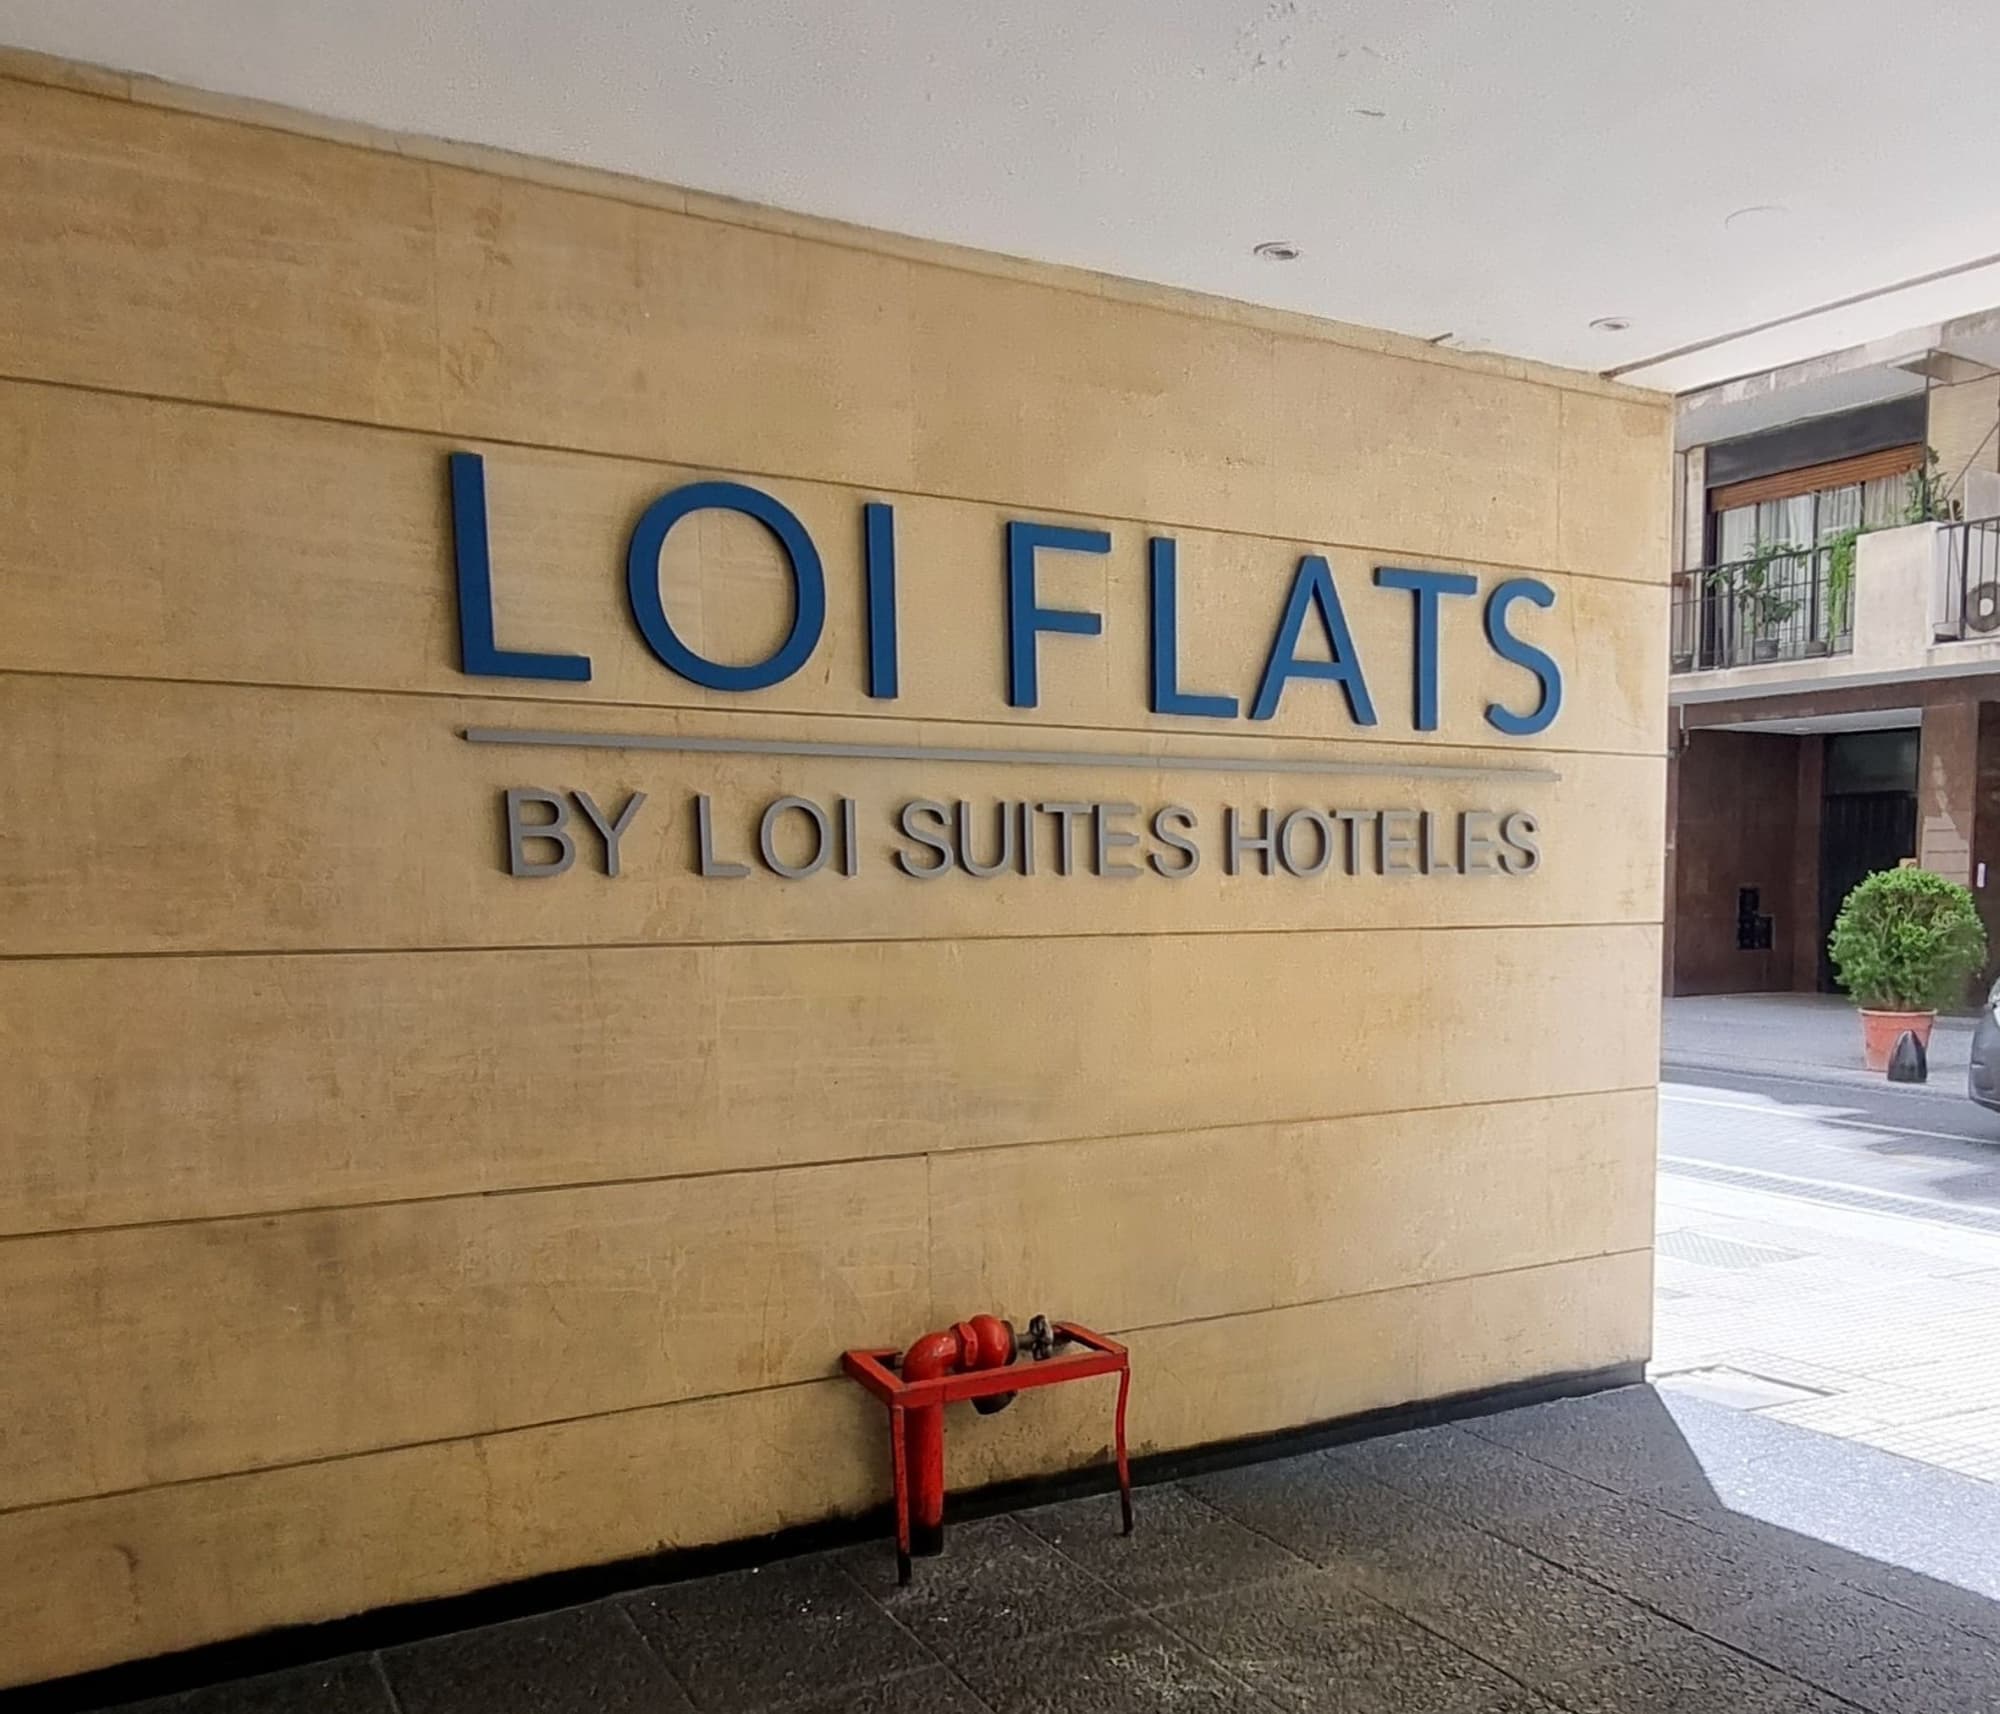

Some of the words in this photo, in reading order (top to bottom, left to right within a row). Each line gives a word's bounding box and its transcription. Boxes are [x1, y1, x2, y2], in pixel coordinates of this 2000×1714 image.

[450, 451, 899, 699] LOI
[1007, 521, 1563, 736] FLATS
[506, 788, 647, 878] BY
[696, 794, 857, 878] LOI
[895, 800, 1200, 878] SUITES
[1226, 806, 1540, 878] HOTELES
